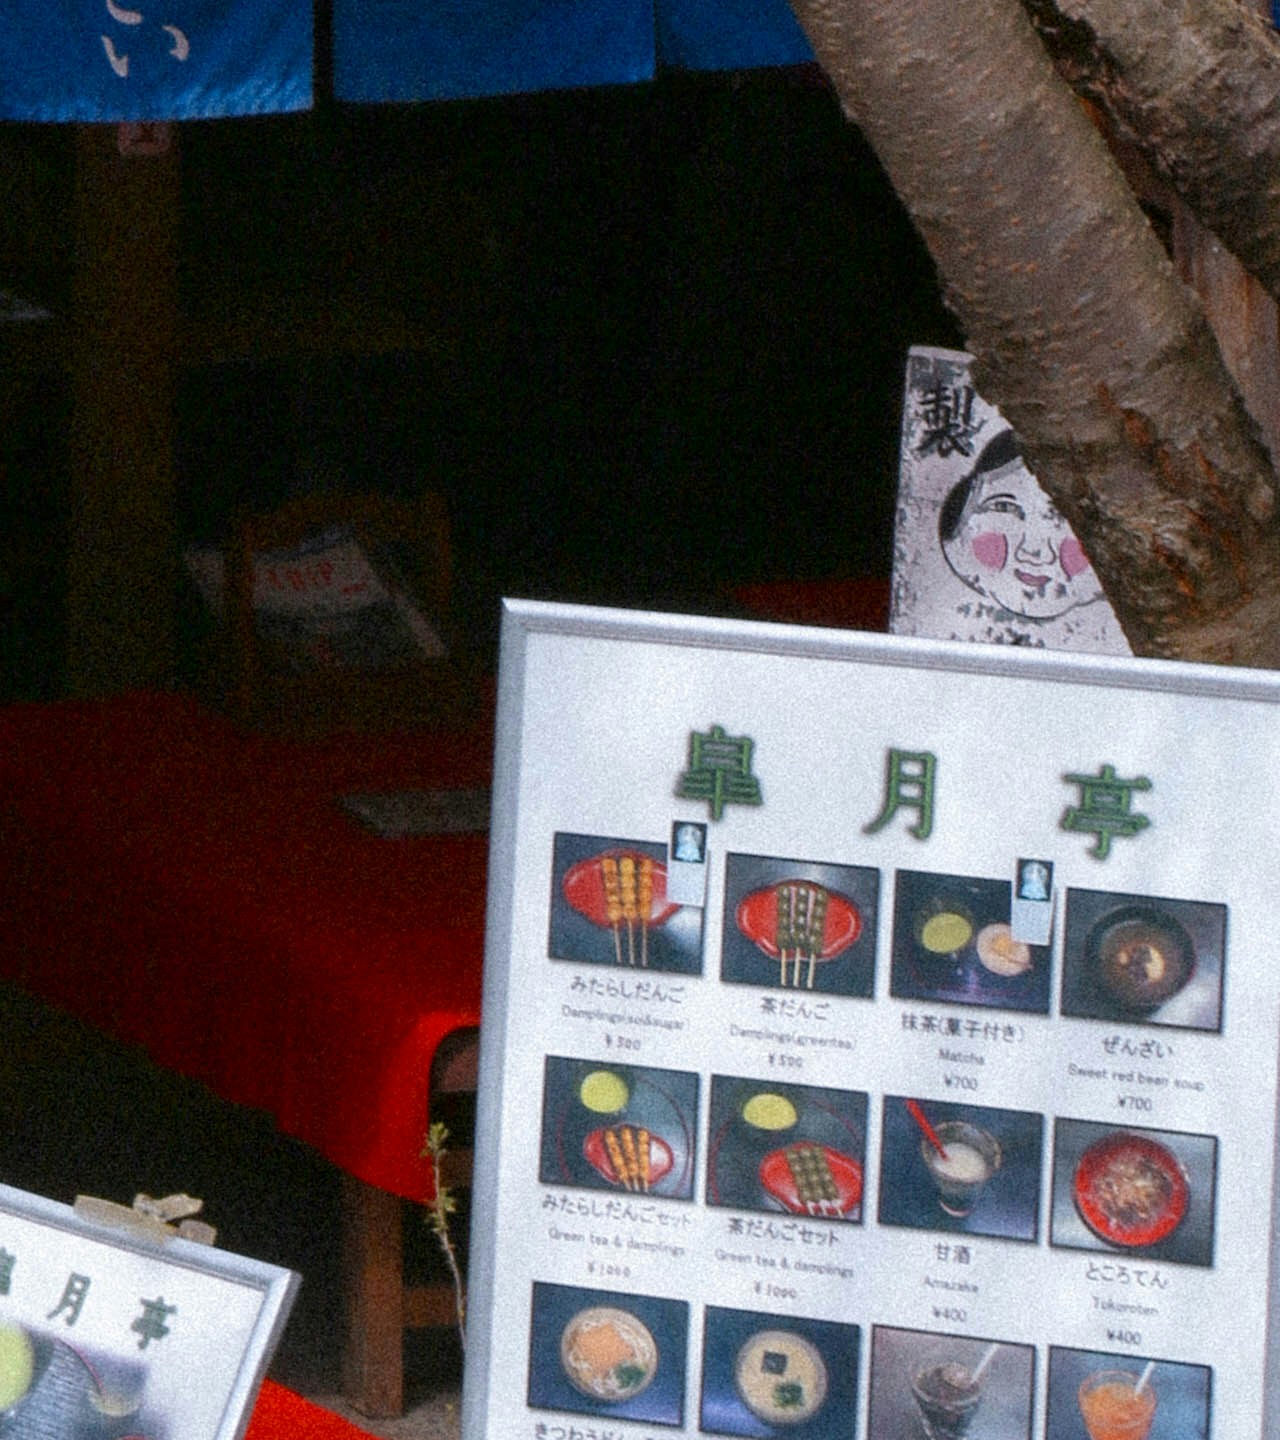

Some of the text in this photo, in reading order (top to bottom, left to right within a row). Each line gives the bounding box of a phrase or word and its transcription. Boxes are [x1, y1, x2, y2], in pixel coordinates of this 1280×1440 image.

[570, 975, 685, 1003] みたらしだんご
[761, 996, 830, 1020] 茶だんご
[938, 1048, 985, 1066] Matcha
[1103, 1034, 1173, 1059] ぜんざい
[944, 1074, 978, 1090] ¥700
[1068, 1064, 1106, 1080] Sweet
[1111, 1069, 1134, 1083] red
[1138, 1072, 1169, 1087] bean
[1118, 1095, 1152, 1112] ¥700
[548, 1227, 586, 1244] Green
[589, 1233, 610, 1247] tea
[728, 1216, 840, 1248] 茶だんごセット
[714, 1248, 753, 1265] Green
[755, 1254, 776, 1270] tea
[934, 1243, 971, 1266] 甘酒
[1086, 1262, 1168, 1290] ところてん
[1106, 1328, 1142, 1345] ¥400
